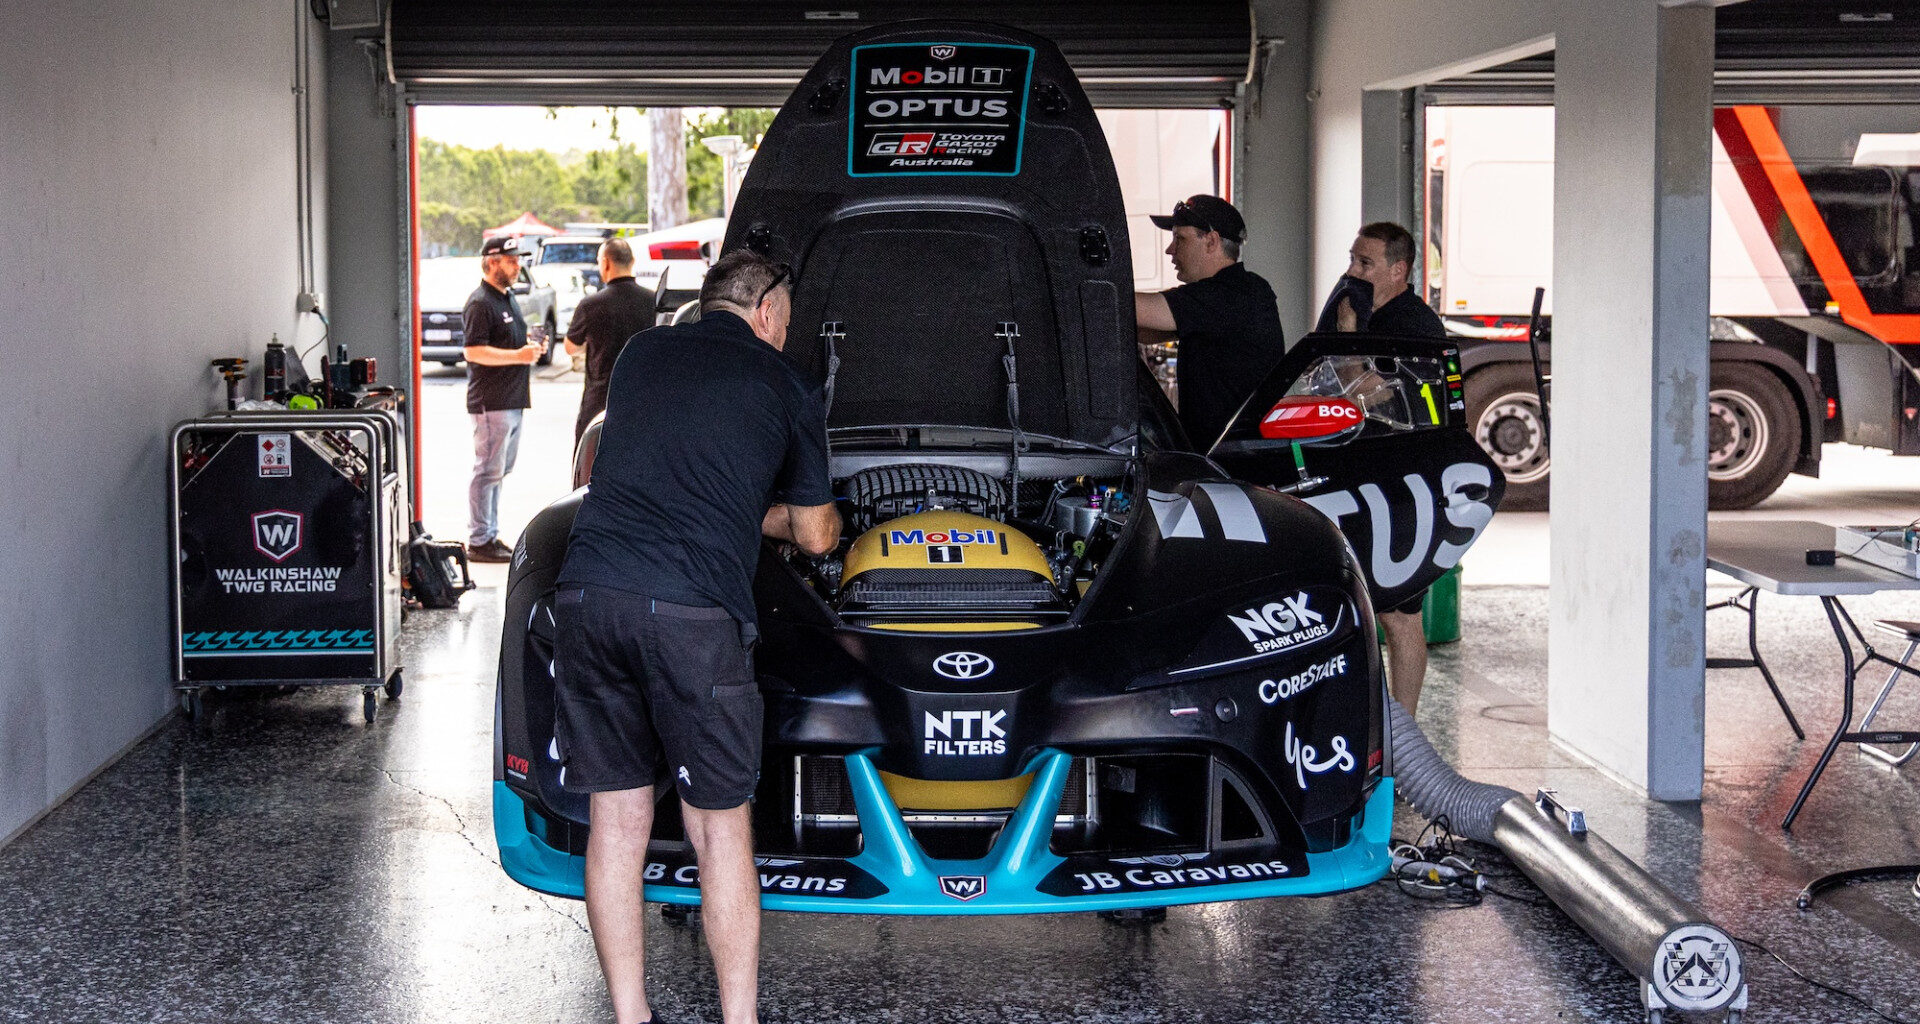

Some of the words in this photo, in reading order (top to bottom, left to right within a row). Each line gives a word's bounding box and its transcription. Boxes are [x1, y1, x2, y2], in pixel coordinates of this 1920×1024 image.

[870, 67, 965, 85] Mobil
[868, 98, 1008, 118] OPTUS
[871, 141, 928, 154] GR
[939, 133, 1005, 141] TOYOTA
[932, 146, 993, 155] Racing
[890, 158, 974, 167] Australia
[1318, 405, 1358, 419] BOC
[1419, 383, 1440, 425] 1
[890, 529, 996, 545] Mobil
[215, 567, 342, 581] WALKINSHAW
[222, 581, 265, 593] TWG
[270, 580, 336, 593] RACING
[1227, 591, 1323, 642] NGK
[1253, 634, 1294, 654] SPARK
[1294, 623, 1329, 643] PLUGS
[925, 709, 1007, 739] NTK
[924, 740, 1006, 755] FILTERS
[643, 862, 667, 880] B
[1074, 871, 1122, 891] JB
[1125, 860, 1289, 887] Caravans
